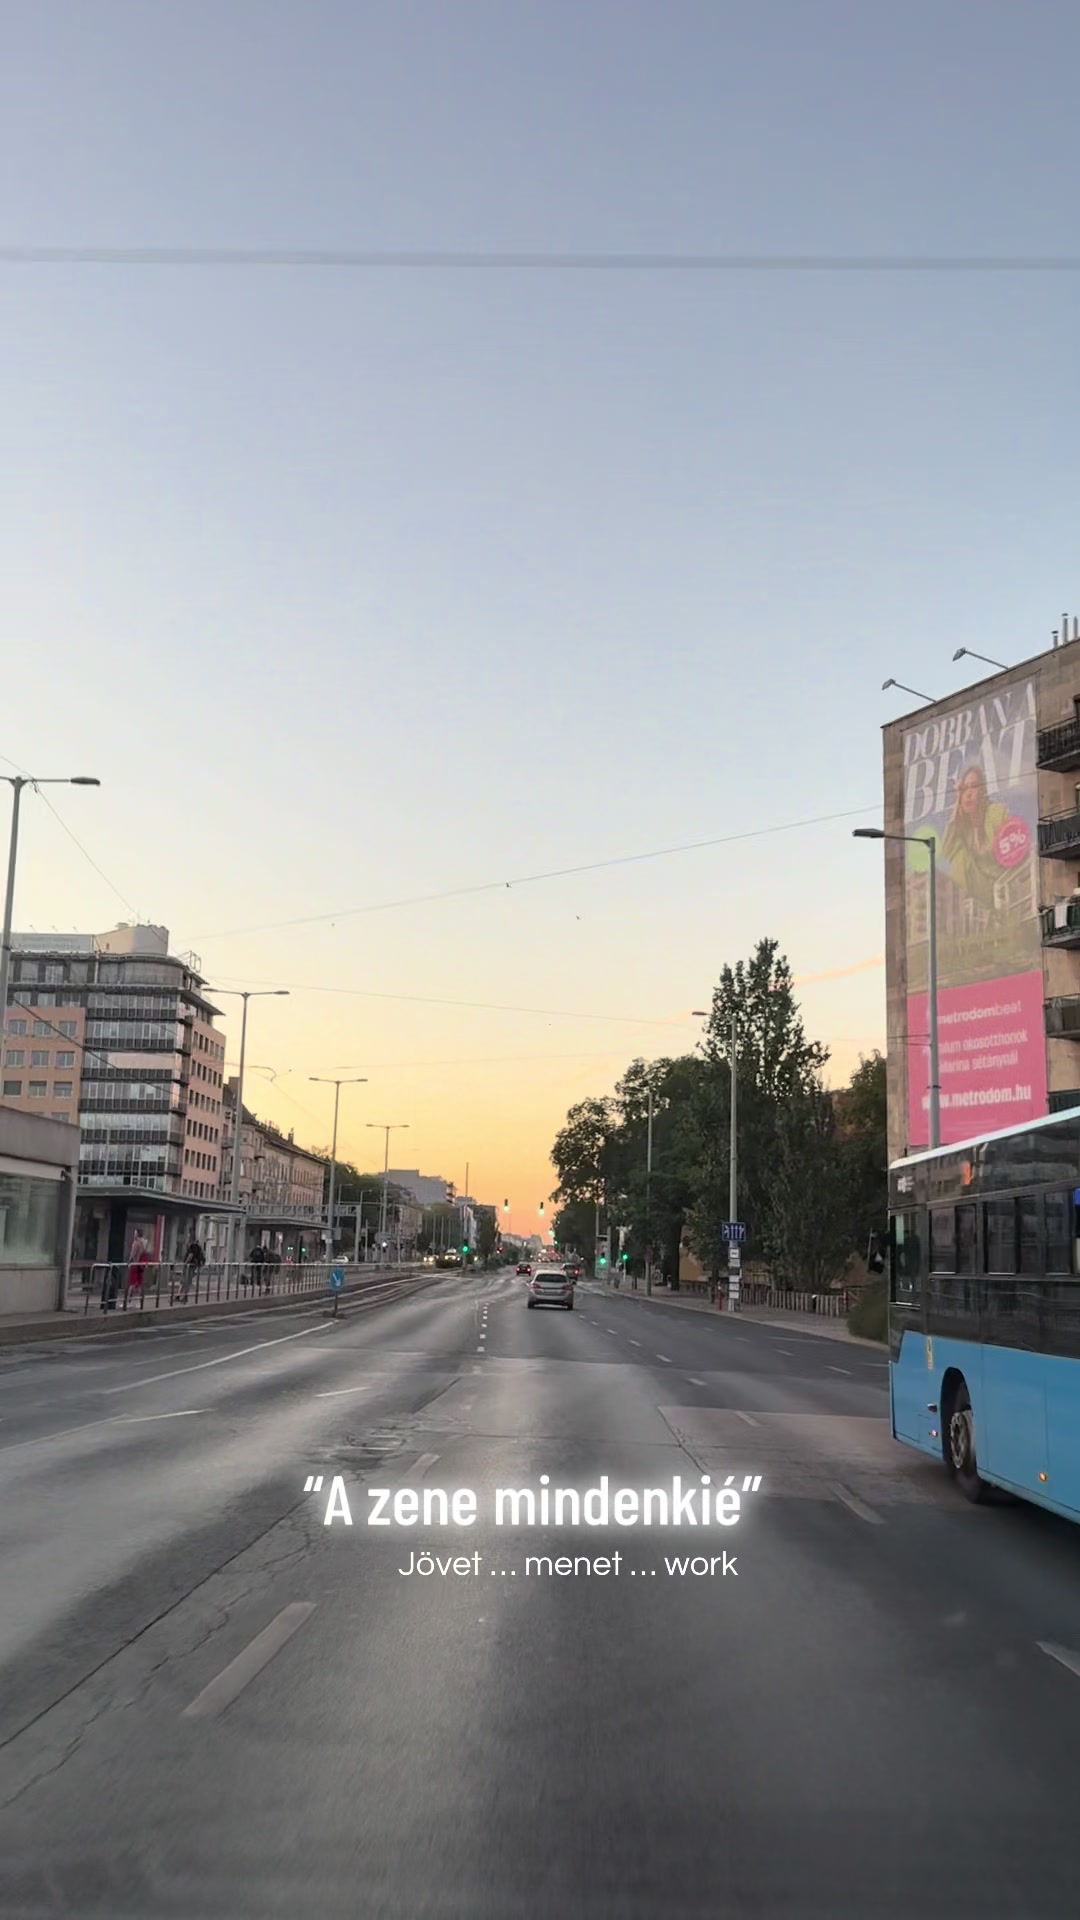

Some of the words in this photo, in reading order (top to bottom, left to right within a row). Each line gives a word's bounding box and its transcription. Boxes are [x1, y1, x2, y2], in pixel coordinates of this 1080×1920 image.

[904, 716, 1037, 825] BEAT
[999, 828, 1027, 855] 5%
[922, 1084, 1032, 1110] ww.metrodom.hu
